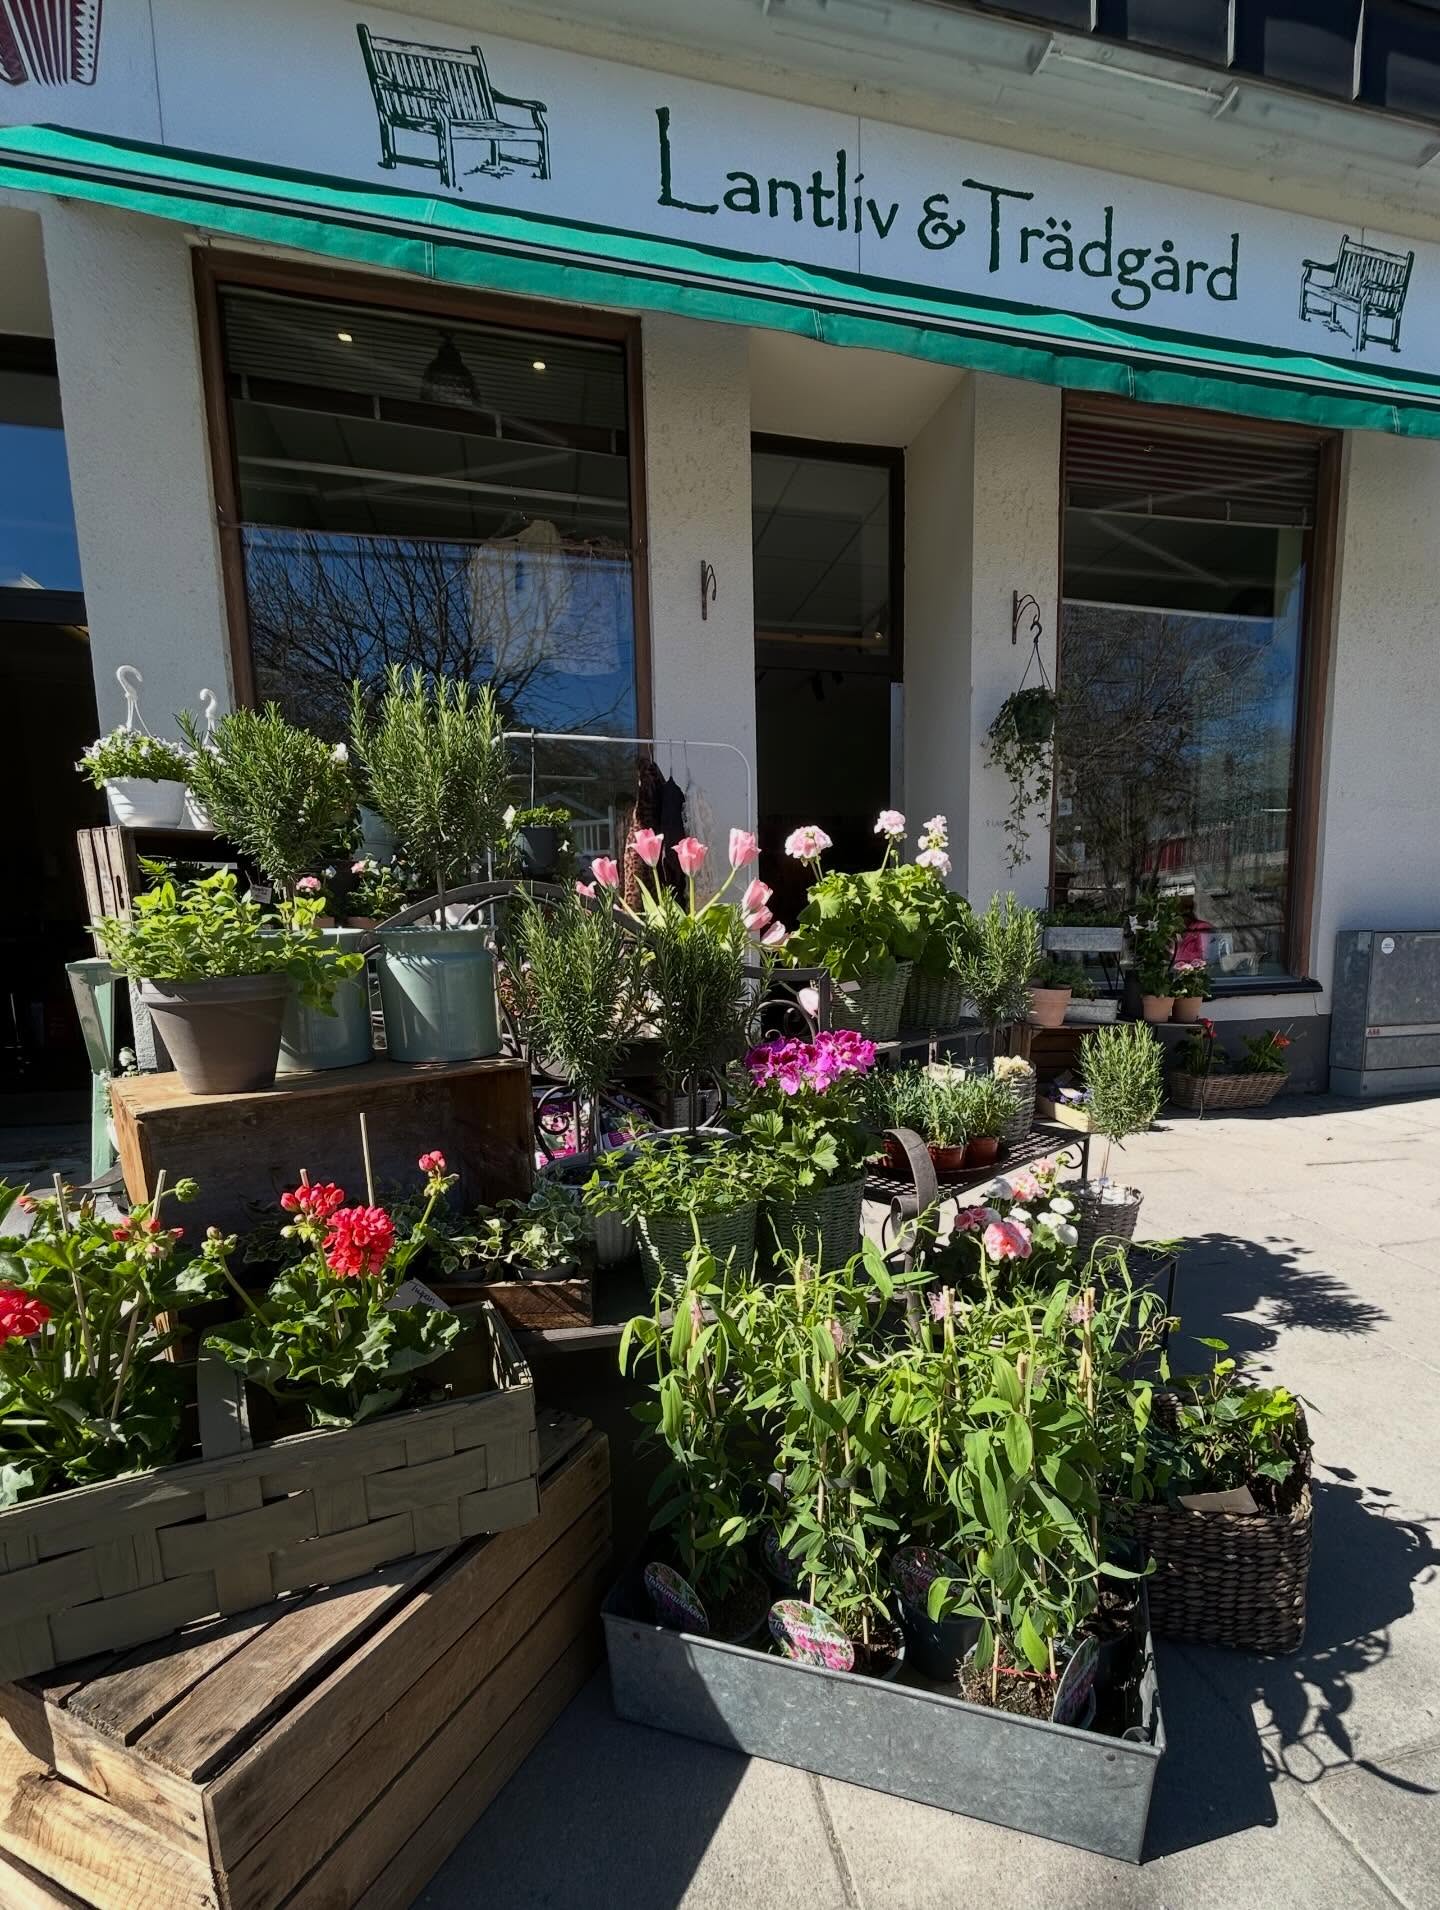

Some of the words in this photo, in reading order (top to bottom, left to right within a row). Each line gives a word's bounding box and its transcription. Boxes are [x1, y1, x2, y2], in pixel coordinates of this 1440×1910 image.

[655, 106, 899, 240] Lantliv
[917, 193, 966, 250] &
[961, 178, 1240, 311] Trädgård
